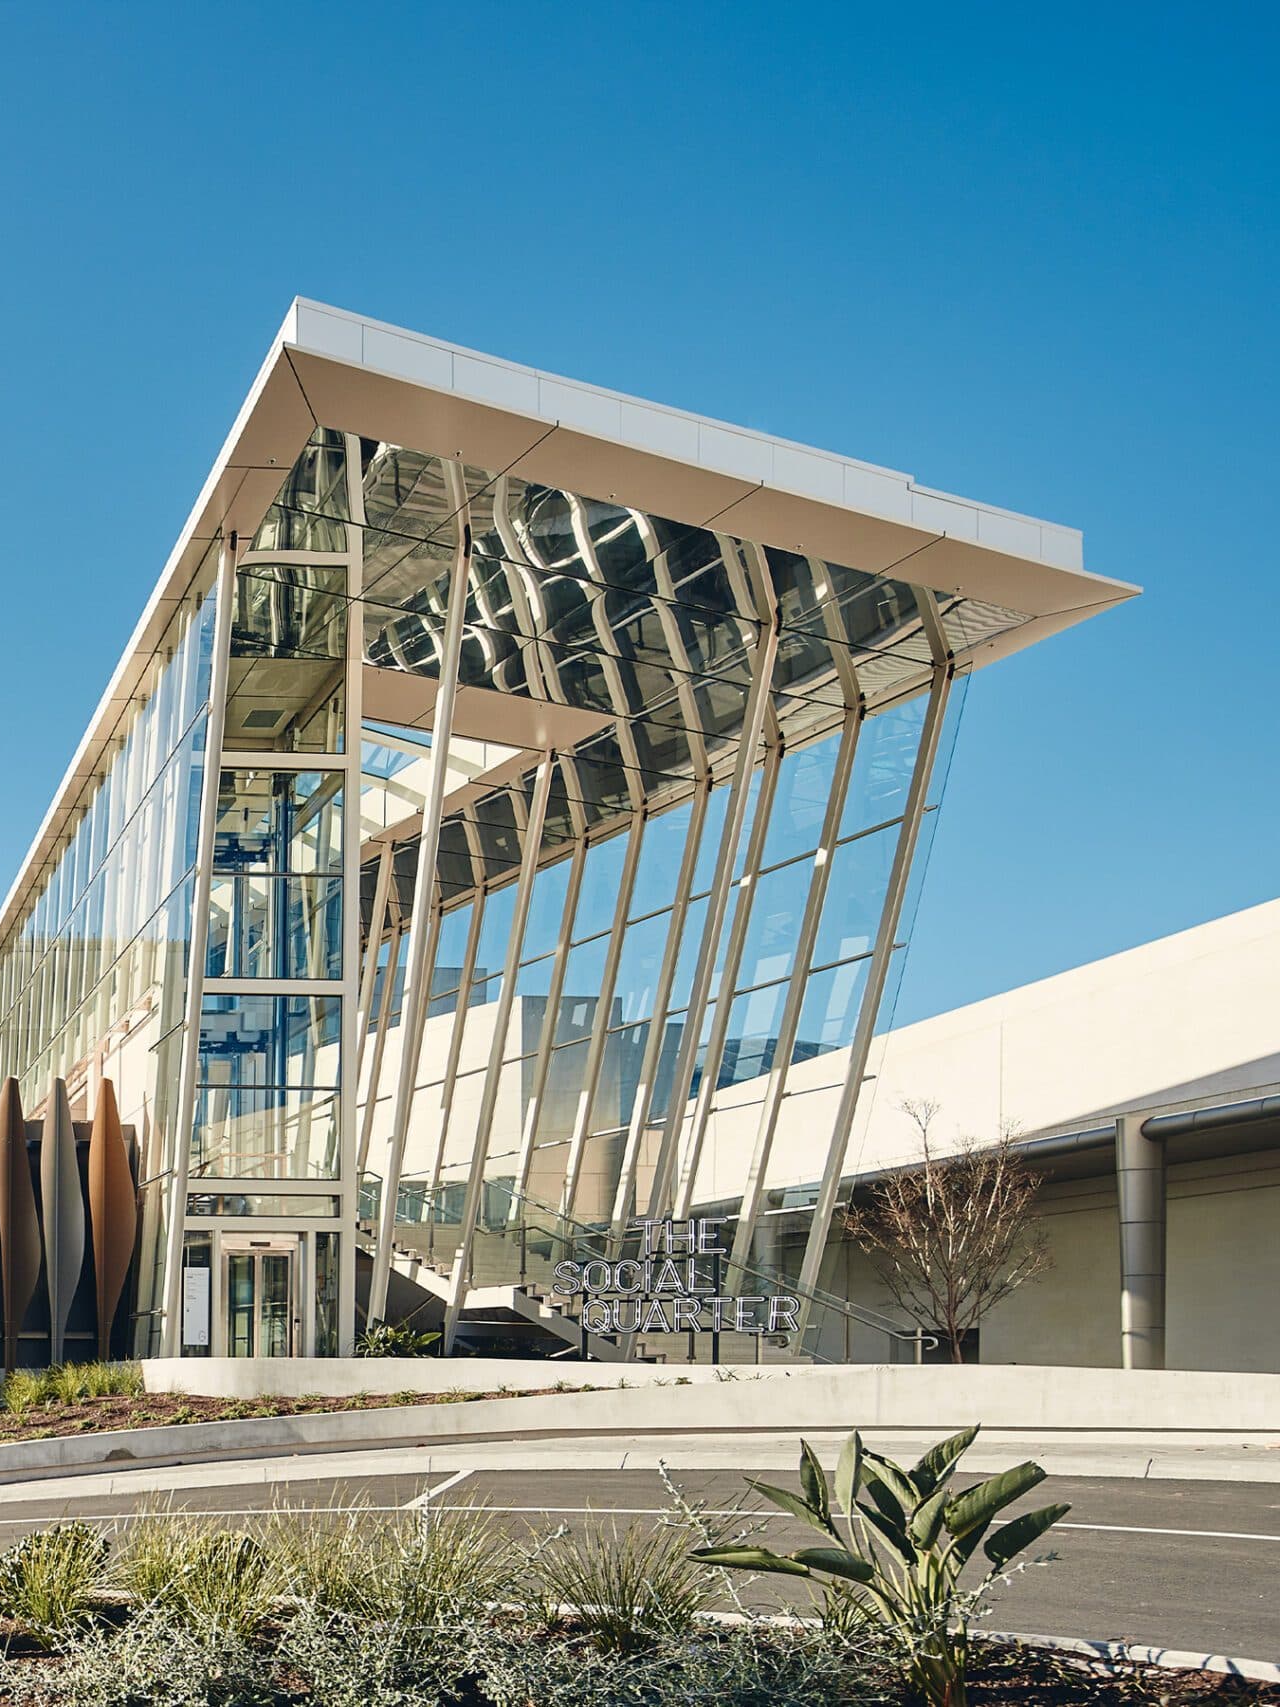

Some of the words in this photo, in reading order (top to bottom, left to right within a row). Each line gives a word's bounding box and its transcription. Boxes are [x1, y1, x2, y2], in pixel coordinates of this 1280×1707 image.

[634, 1217, 728, 1255] THE
[552, 1258, 717, 1295] SOCIAL
[581, 1295, 801, 1334] QUARTER
